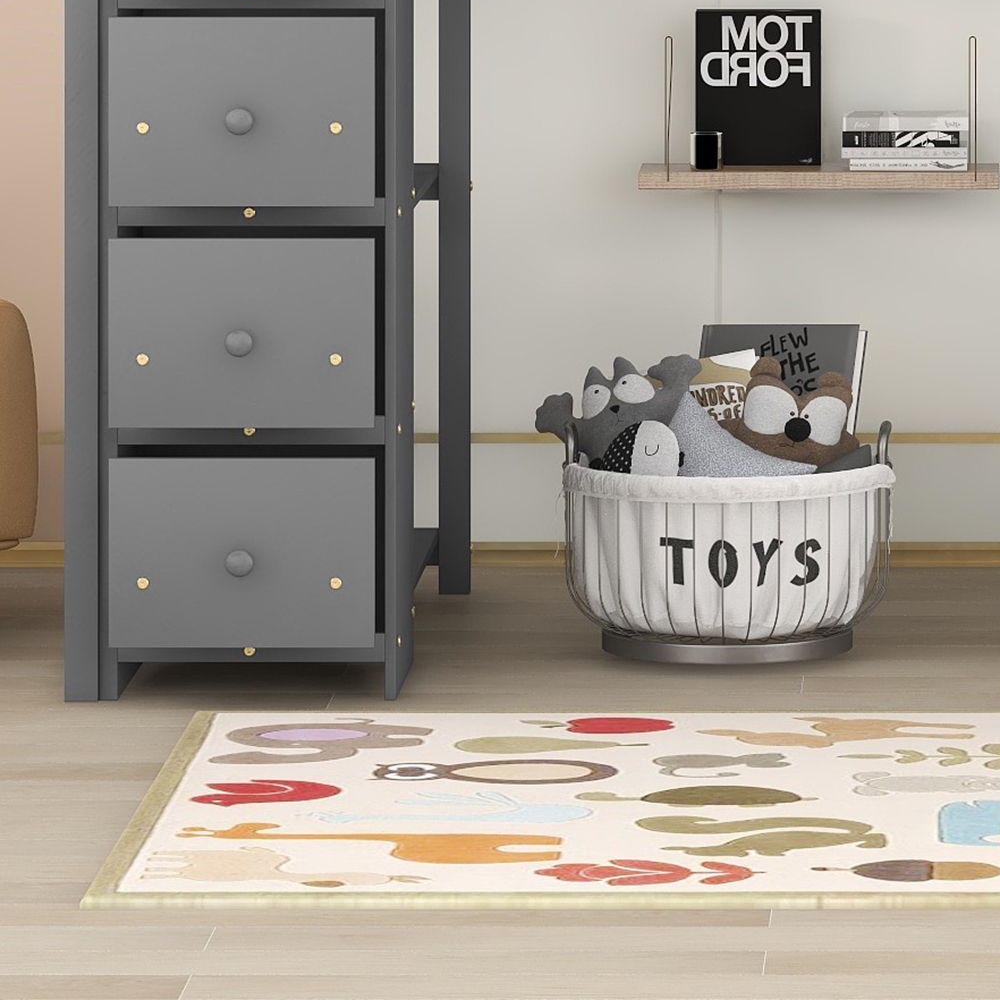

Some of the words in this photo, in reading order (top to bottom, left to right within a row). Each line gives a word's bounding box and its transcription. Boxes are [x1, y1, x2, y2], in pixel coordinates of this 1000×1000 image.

[760, 327, 808, 357] FLEW
[780, 352, 820, 381] THE
[690, 384, 746, 408] NDRED
[659, 537, 822, 589] TOYS
